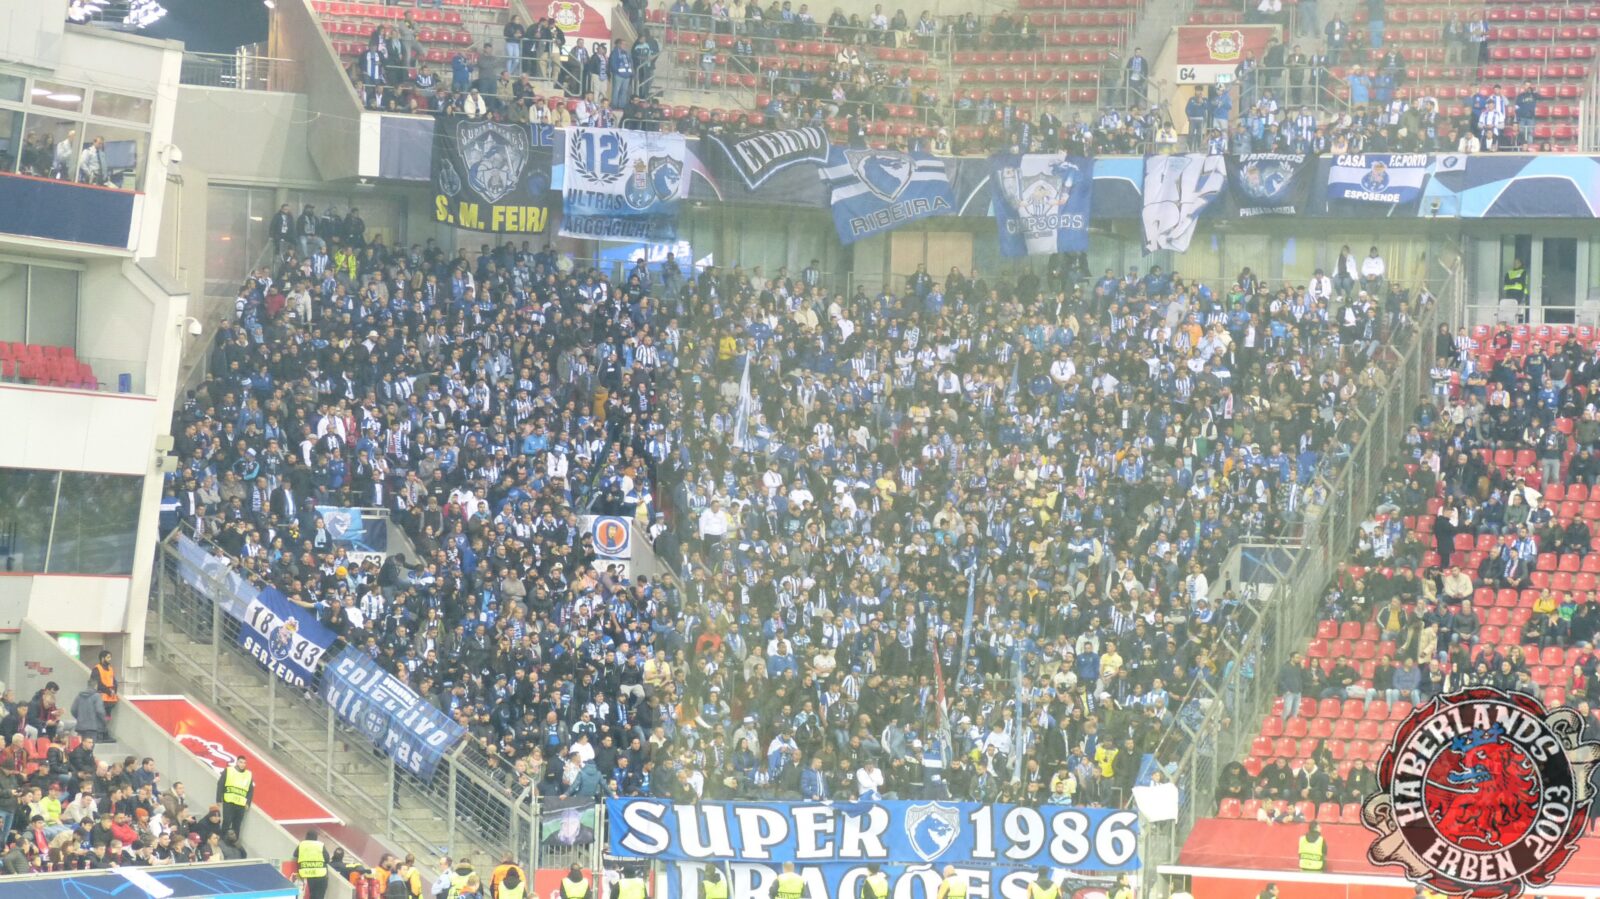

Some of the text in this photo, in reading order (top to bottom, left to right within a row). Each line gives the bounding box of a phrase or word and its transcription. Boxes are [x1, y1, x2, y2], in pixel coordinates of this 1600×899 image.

[1180, 67, 1196, 80] G4
[579, 132, 619, 175] 12
[735, 127, 821, 174] ETERNO
[1336, 154, 1366, 168] CASA
[435, 194, 454, 224] S.
[459, 201, 485, 230] M.
[567, 188, 624, 210] ULTRAS
[1343, 189, 1400, 203] ESPOSENDE
[850, 196, 950, 236] RIBEIRA
[251, 606, 275, 634] 18
[293, 640, 320, 667] 93
[621, 801, 1138, 867] SUPER 1986
